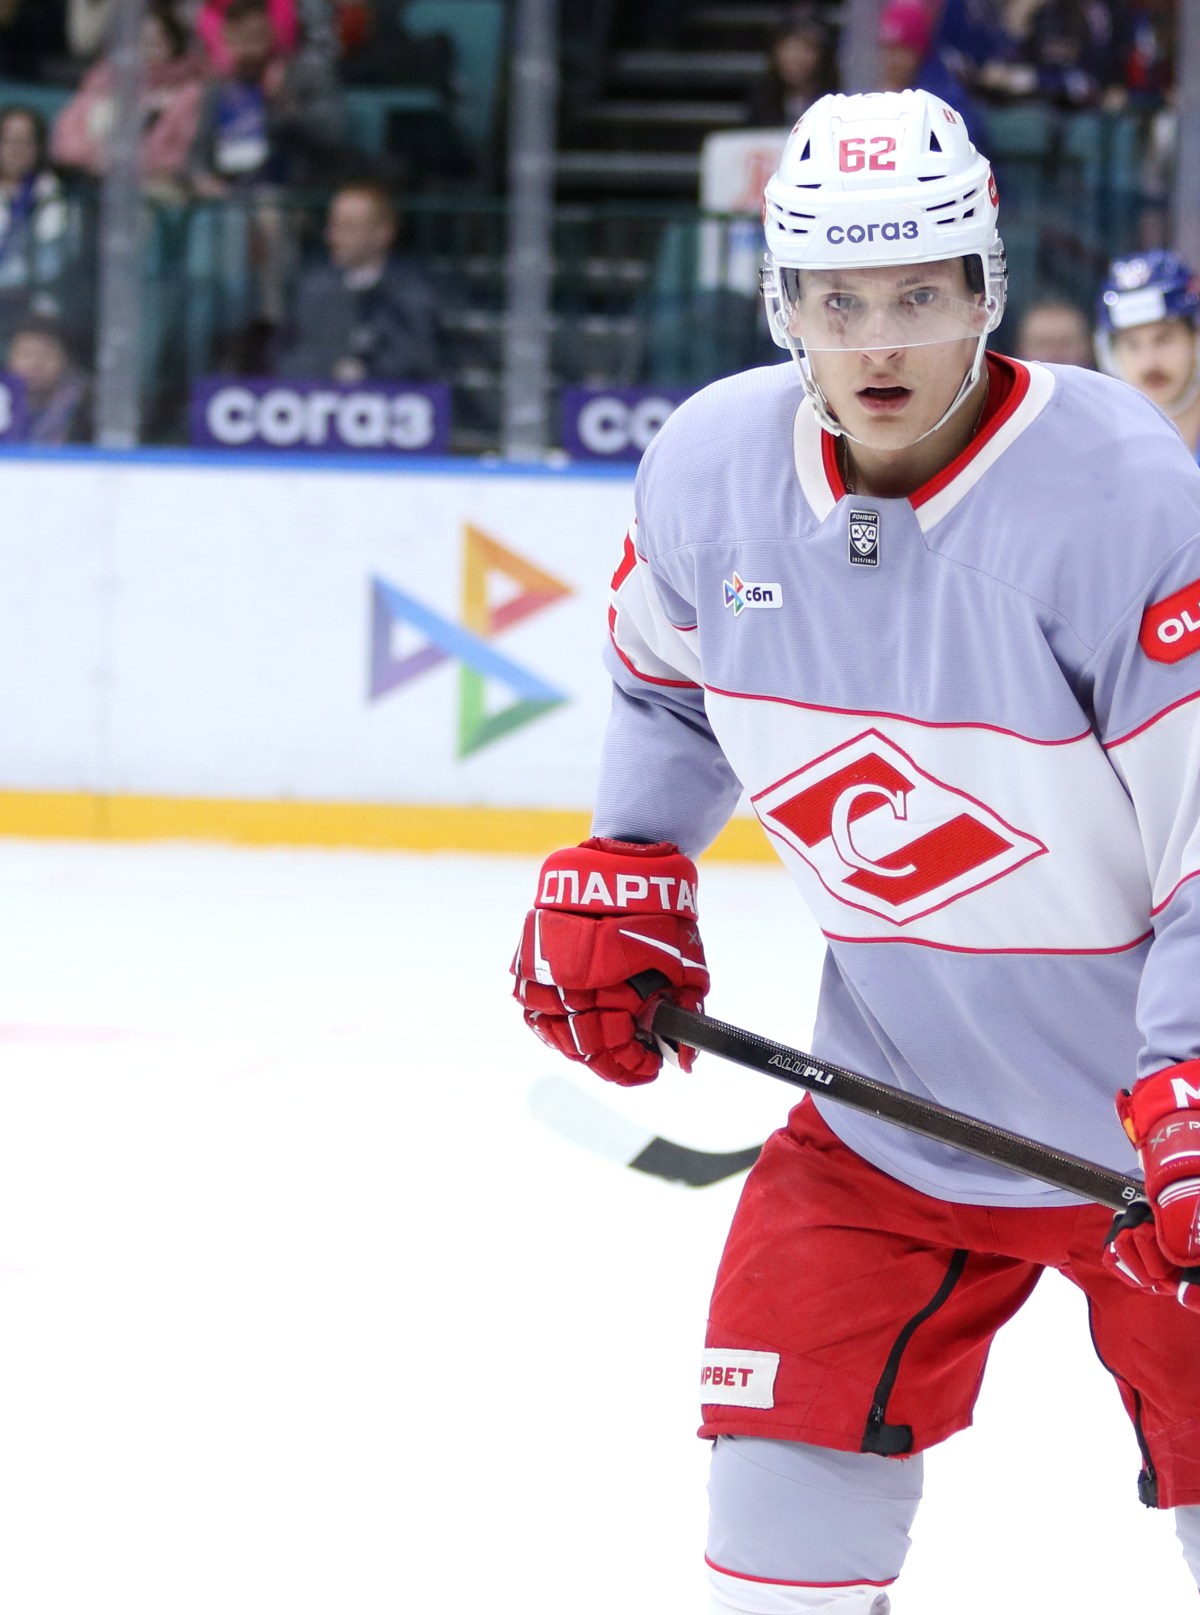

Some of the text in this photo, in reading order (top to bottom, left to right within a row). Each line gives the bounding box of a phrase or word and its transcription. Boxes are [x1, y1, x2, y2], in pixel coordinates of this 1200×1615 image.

[838, 136, 897, 173] 62
[826, 219, 920, 245] согаз
[206, 386, 435, 450] согаз
[745, 586, 774, 602] сбп
[767, 1053, 834, 1086] ALUPLI
